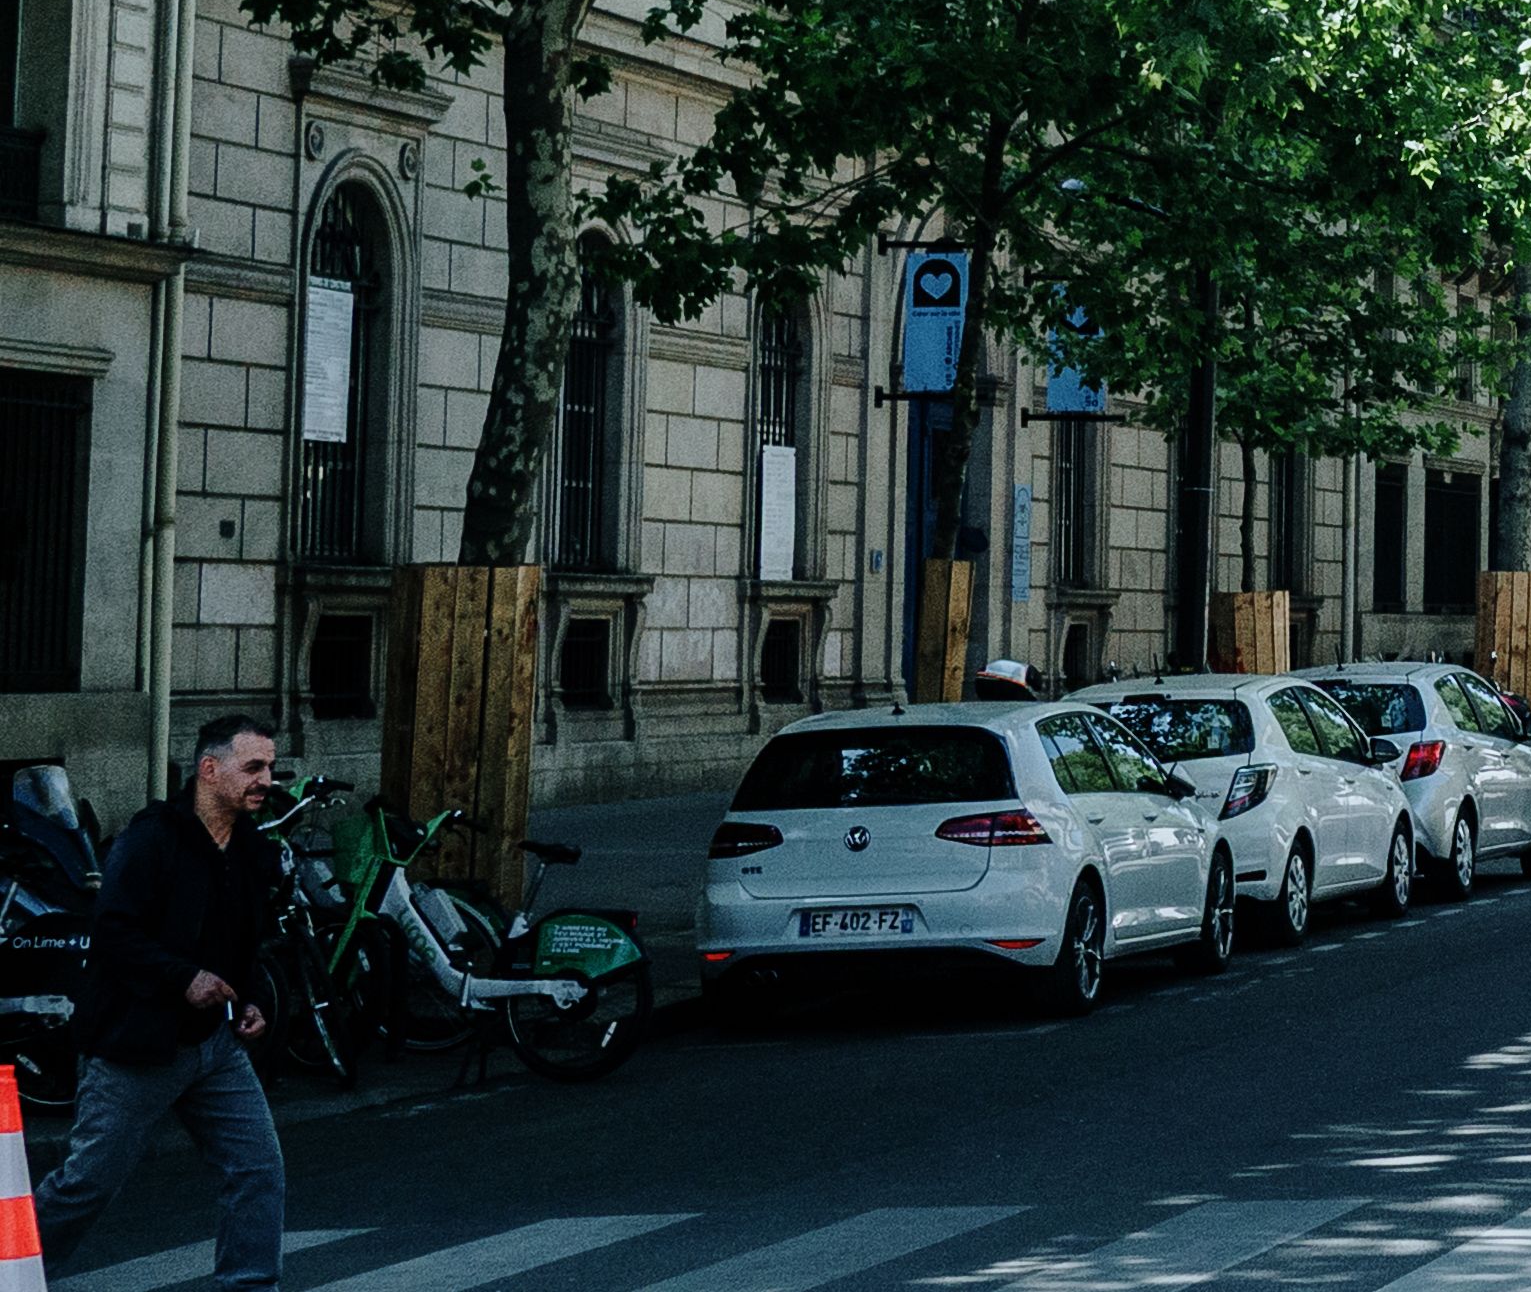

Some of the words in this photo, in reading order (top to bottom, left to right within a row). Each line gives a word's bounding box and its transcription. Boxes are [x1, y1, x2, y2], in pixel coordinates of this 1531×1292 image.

[811, 911, 900, 933] EF-402-FZ
[12, 936, 31, 949] On
[33, 935, 66, 949] Lime
